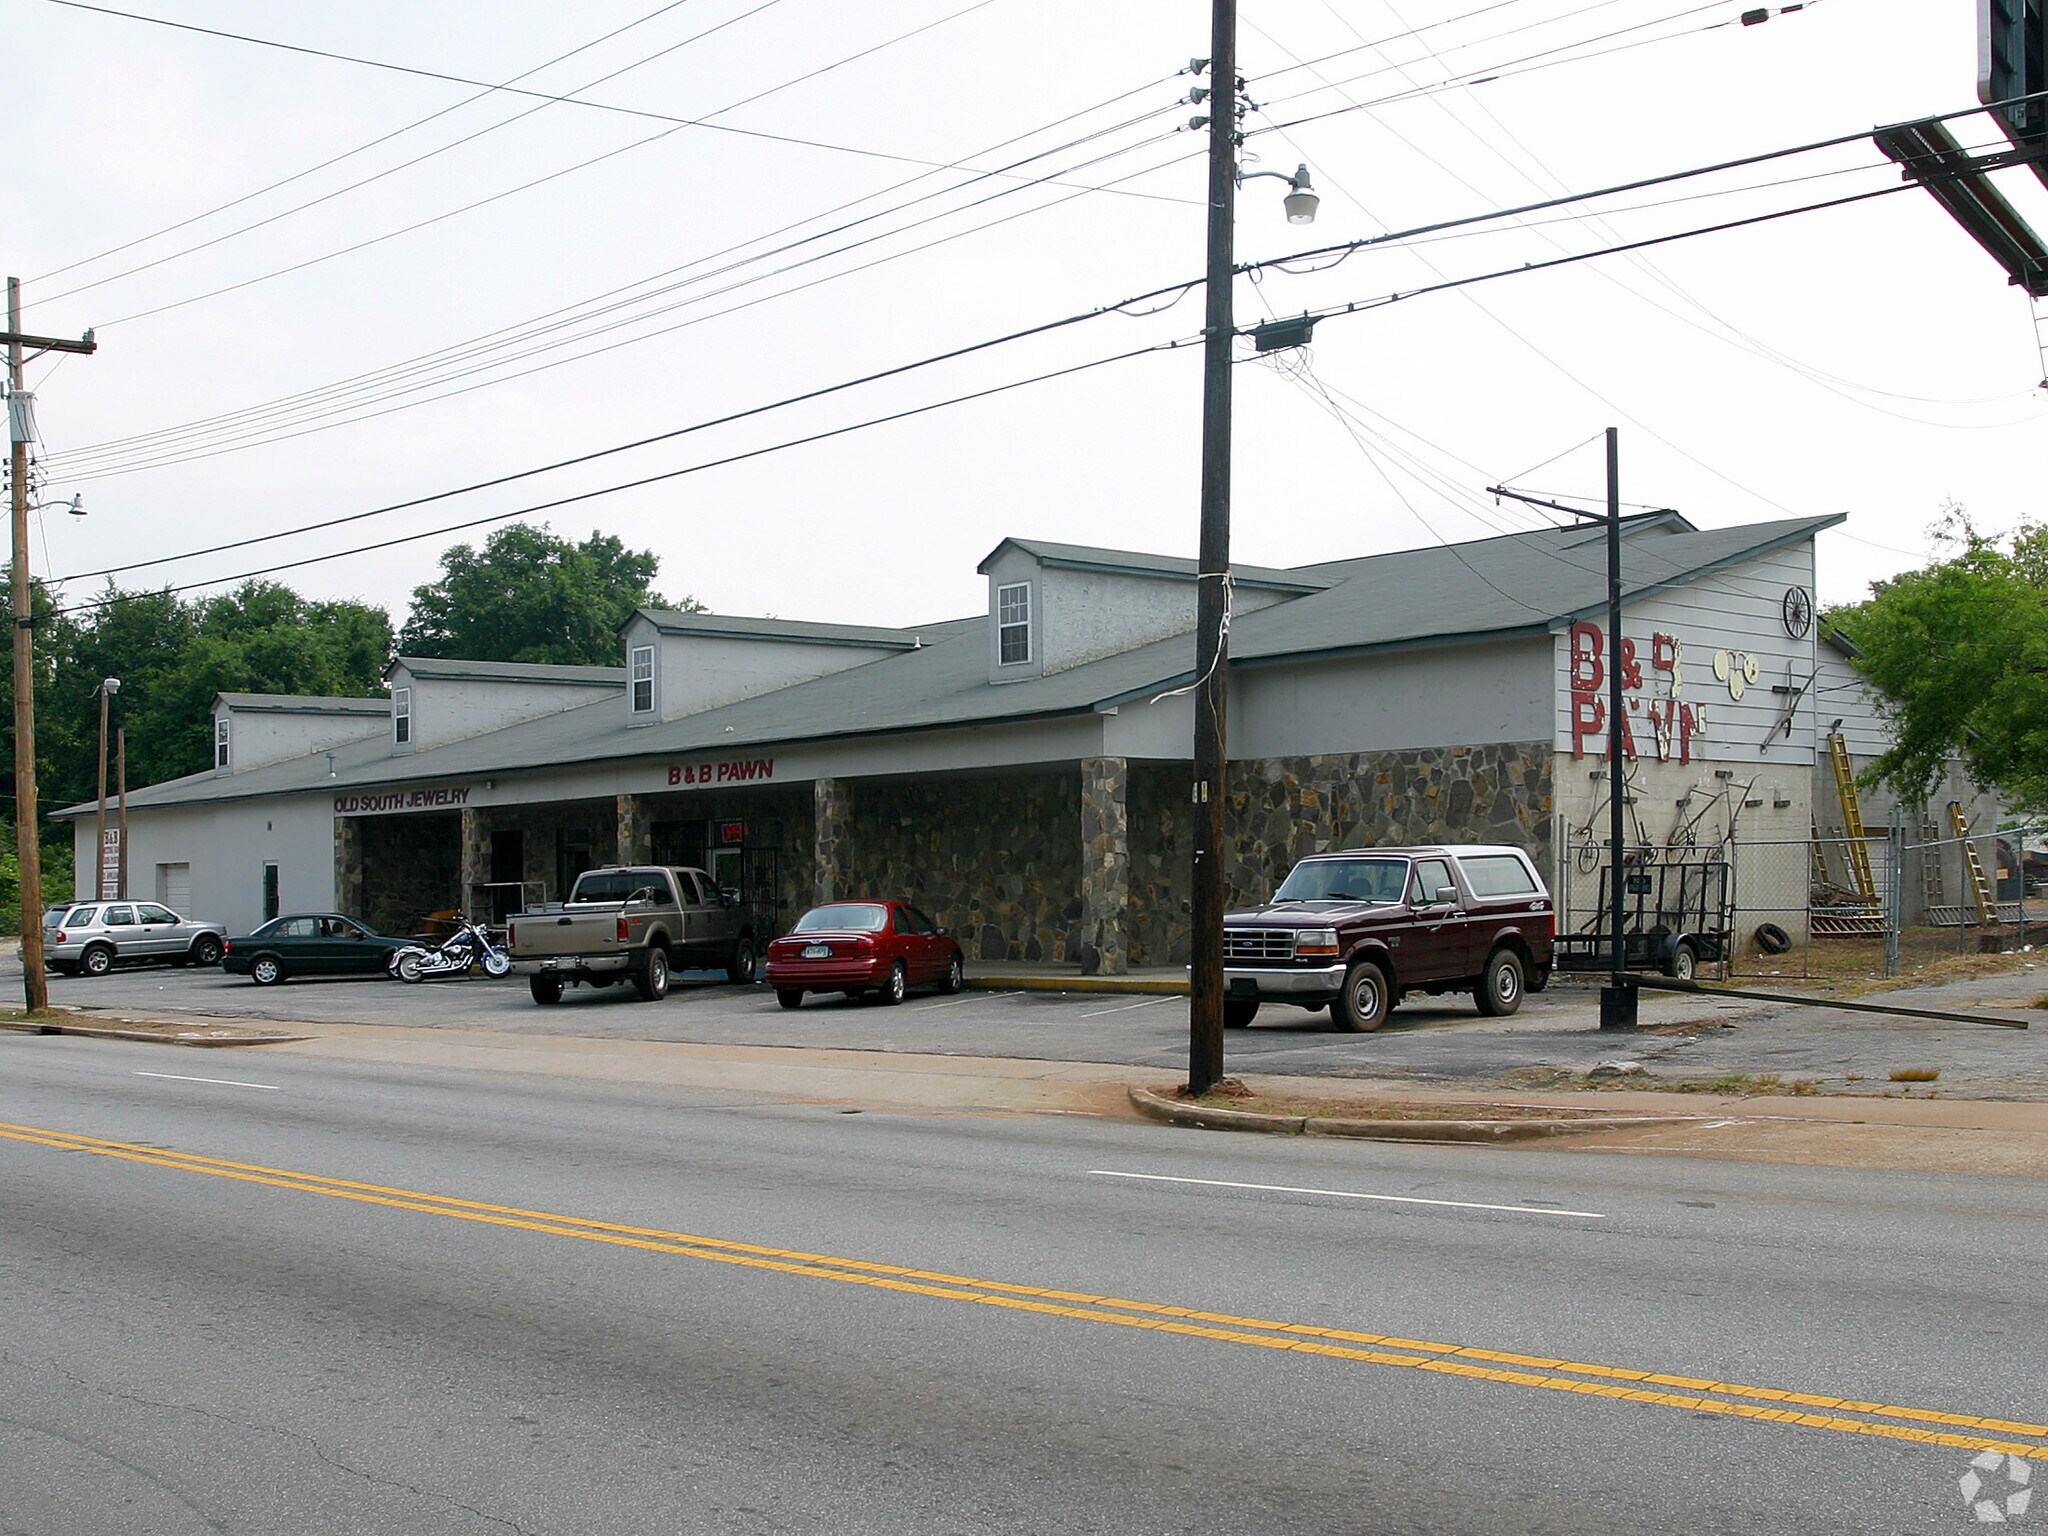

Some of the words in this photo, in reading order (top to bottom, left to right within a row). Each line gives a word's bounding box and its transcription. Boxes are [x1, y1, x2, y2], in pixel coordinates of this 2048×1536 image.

[717, 759, 774, 782] PAWN
[334, 797, 359, 813] OLD
[360, 794, 404, 811] SOUTH
[406, 788, 470, 807] JEWELRY
